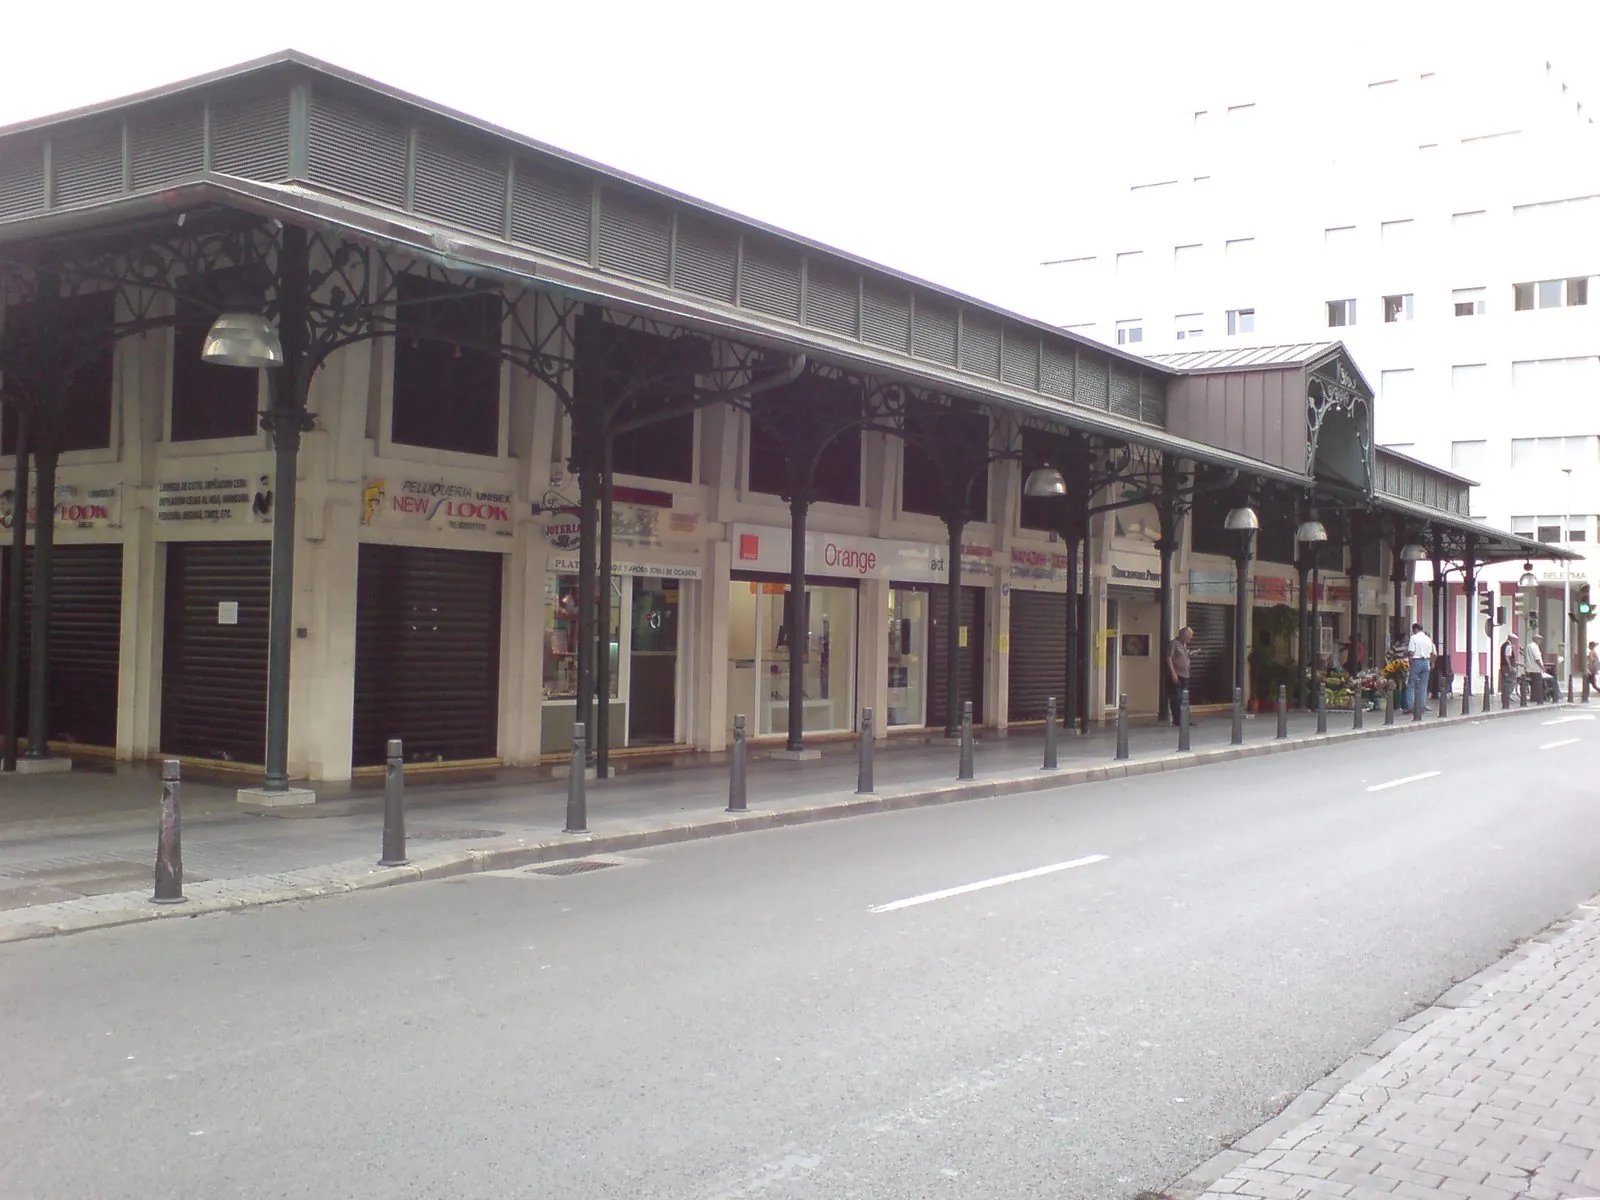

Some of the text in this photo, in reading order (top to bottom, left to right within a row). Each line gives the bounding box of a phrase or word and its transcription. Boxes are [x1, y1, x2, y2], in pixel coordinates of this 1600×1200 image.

[402, 480, 511, 504] PELUQUERIA UNISEX
[61, 504, 107, 521] LOOK
[393, 496, 509, 521] NEW LOOK
[825, 543, 876, 574] Orange
